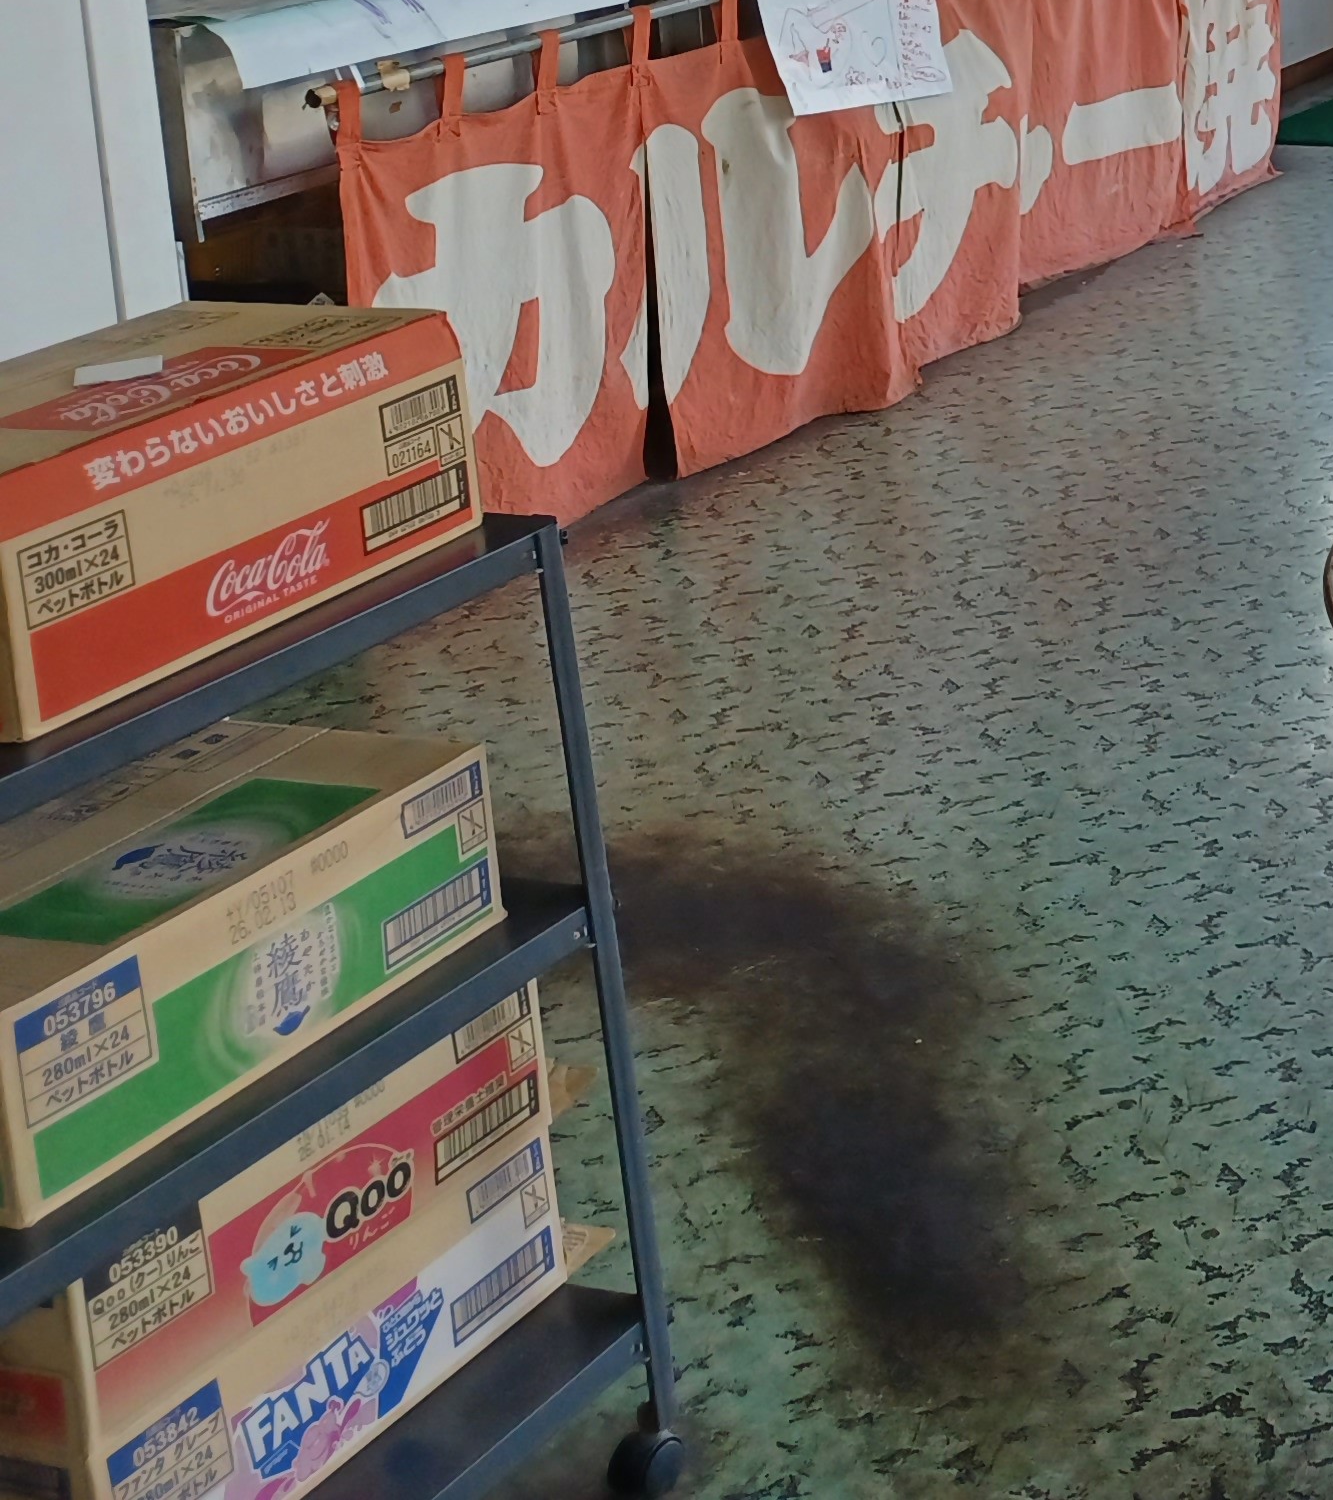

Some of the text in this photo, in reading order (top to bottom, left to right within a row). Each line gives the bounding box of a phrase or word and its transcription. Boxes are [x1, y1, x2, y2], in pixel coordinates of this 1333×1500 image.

[82, 350, 390, 492] 変わらないおいしさと刺激
[390, 443, 432, 470] 021164
[26, 520, 121, 571] コカ・コーラ
[33, 547, 122, 596] 300ml×24
[36, 567, 125, 618] ペットボトル
[223, 573, 319, 626] ORIGINAL TASTE
[265, 930, 310, 1024] 綾鷹
[42, 979, 117, 1038] 053796
[42, 1022, 132, 1089] 280ml×24
[45, 1049, 136, 1109] ペットボトル
[325, 1159, 413, 1241] Qoo
[108, 1225, 179, 1282] 053390
[108, 1272, 192, 1331] 280ml×24
[111, 1292, 196, 1352] ペットボトル
[243, 1334, 373, 1462] FANTA
[132, 1406, 199, 1467] 053842
